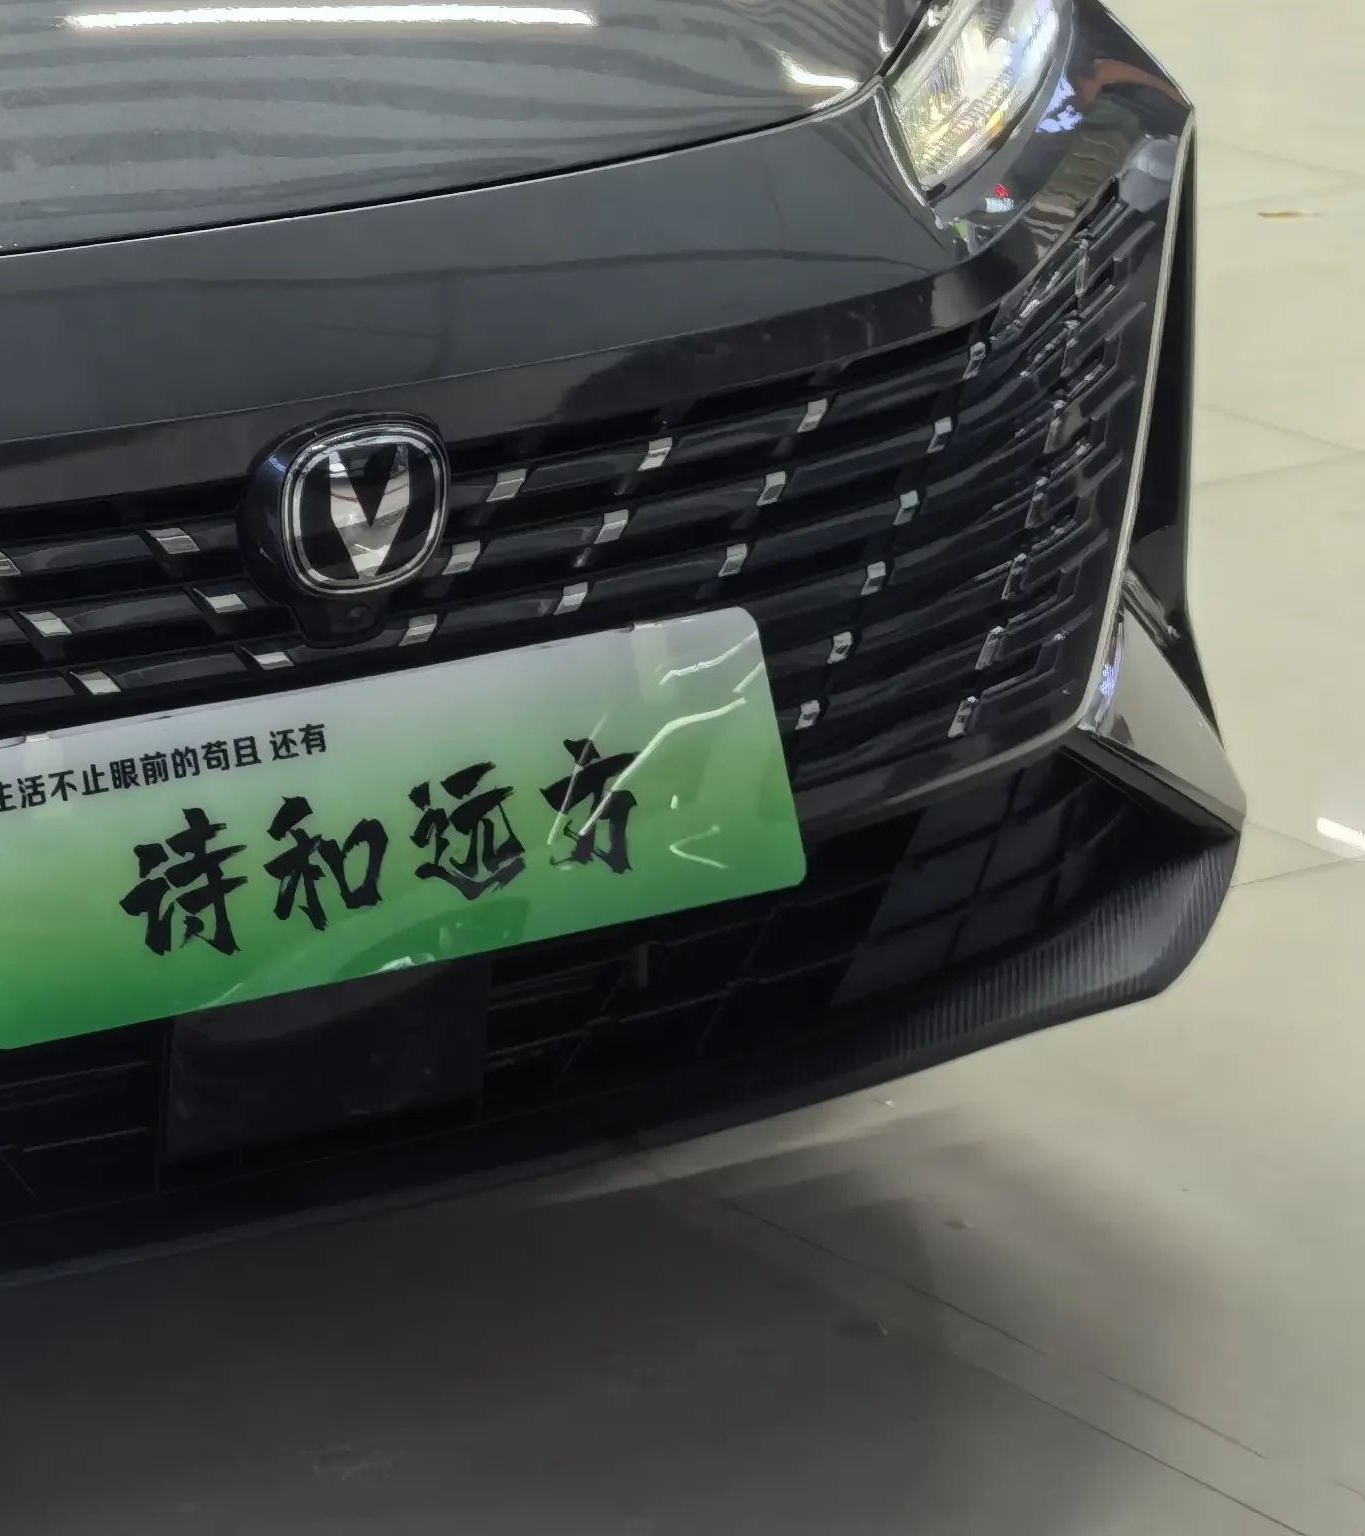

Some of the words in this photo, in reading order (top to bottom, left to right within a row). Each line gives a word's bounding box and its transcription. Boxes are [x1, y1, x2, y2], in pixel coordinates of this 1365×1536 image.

[268, 722, 329, 763] 还有
[118, 736, 643, 956] 诗和远方
